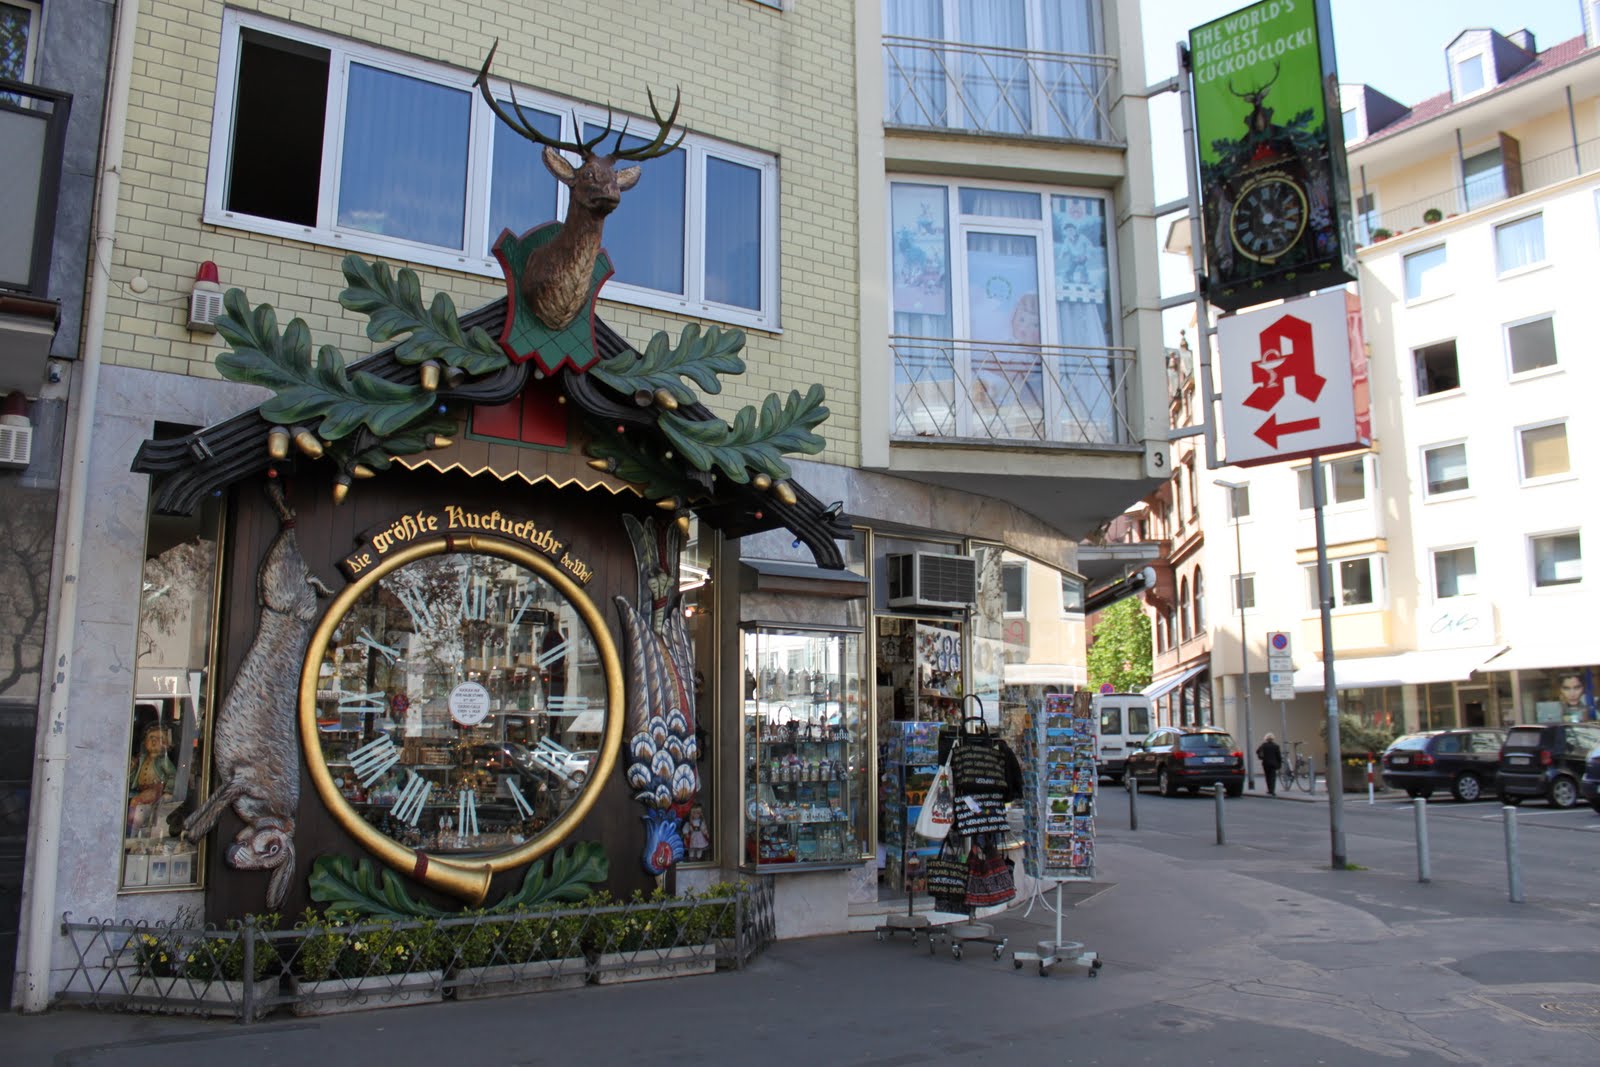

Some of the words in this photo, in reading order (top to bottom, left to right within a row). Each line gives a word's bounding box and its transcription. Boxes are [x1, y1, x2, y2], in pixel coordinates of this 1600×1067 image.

[1194, 25, 1222, 49] THE
[1223, 0, 1295, 35] WORLD'S
[1196, 28, 1259, 67] BIGGEST
[1198, 27, 1313, 84] CUCKOOCLOCK!
[1154, 451, 1164, 468] 3
[346, 553, 372, 573] Die
[372, 510, 438, 553] größte
[444, 505, 562, 554] Kuckuckuhr
[560, 552, 575, 570] der
